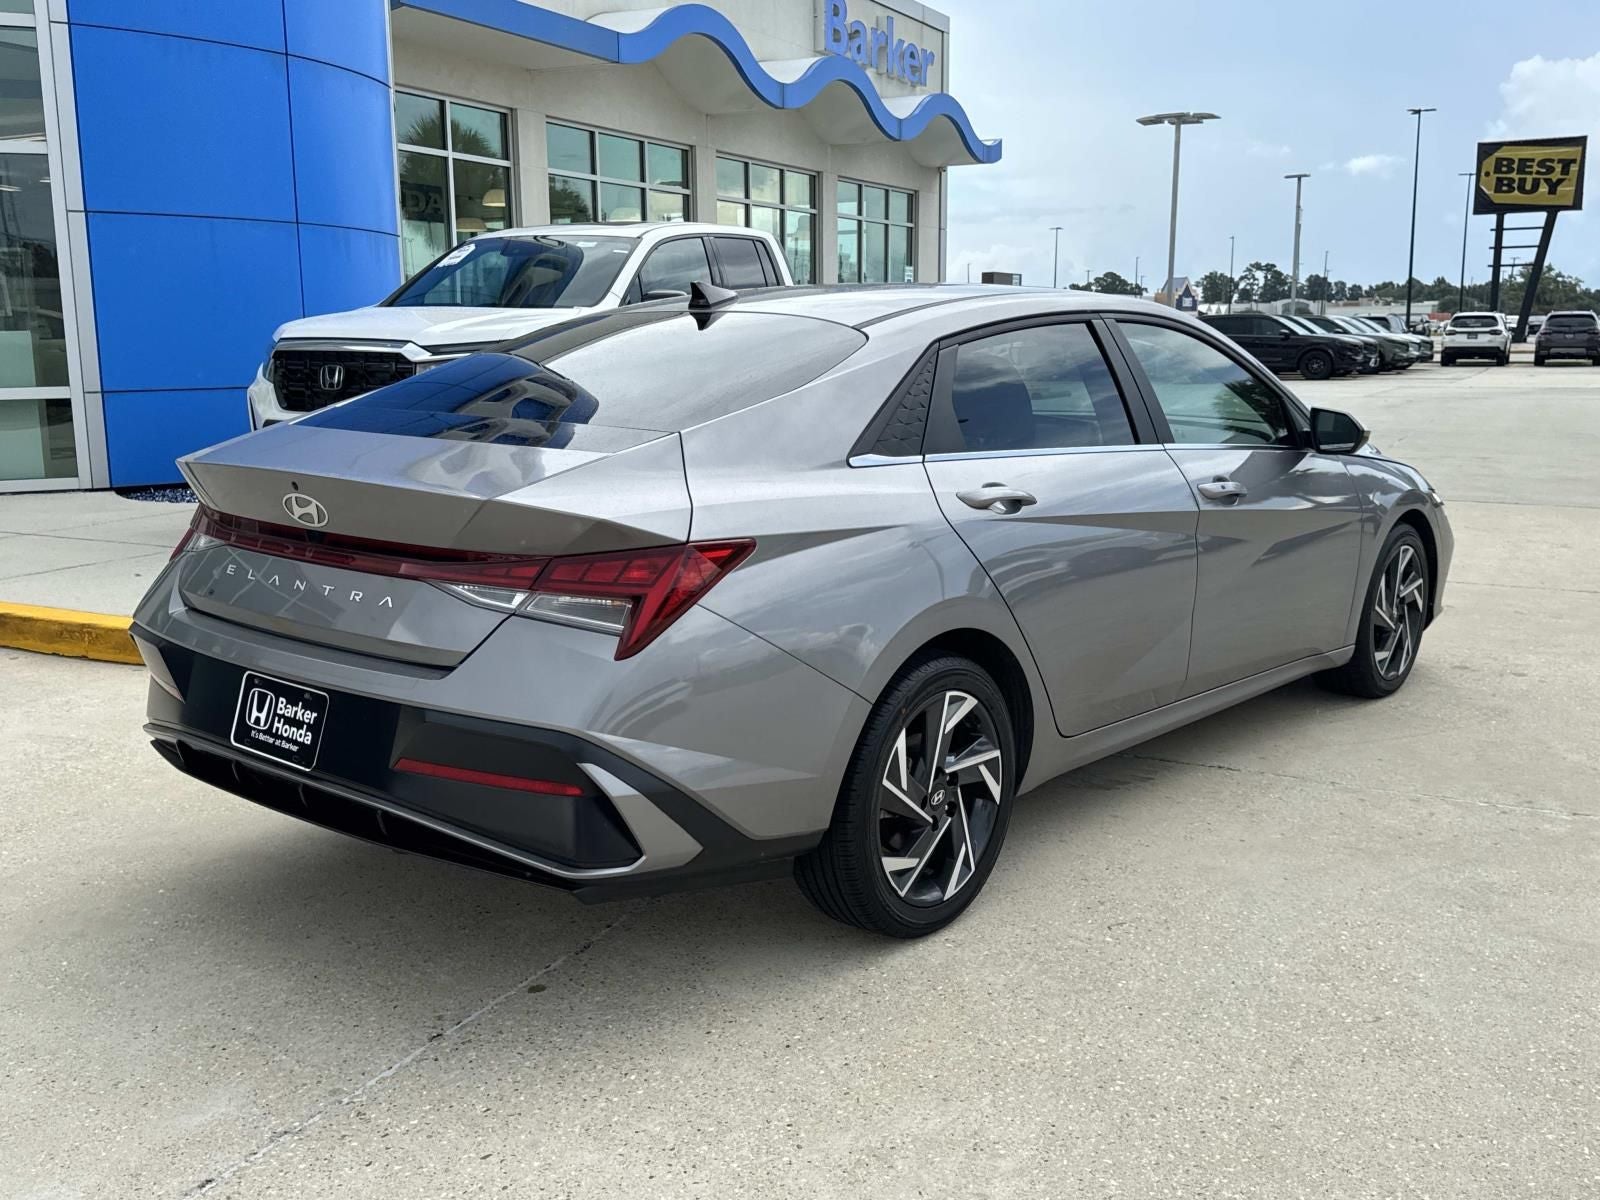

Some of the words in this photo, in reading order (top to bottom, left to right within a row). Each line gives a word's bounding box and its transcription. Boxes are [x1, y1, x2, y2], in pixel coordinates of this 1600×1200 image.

[824, 0, 935, 87] Barker
[1493, 157, 1577, 176] BEST
[1493, 176, 1567, 195] BUY
[226, 563, 393, 608] ELANTRA
[277, 697, 317, 724] Barker
[259, 732, 275, 744] Better
[281, 740, 299, 752] Barker
[272, 716, 312, 745] Honda
